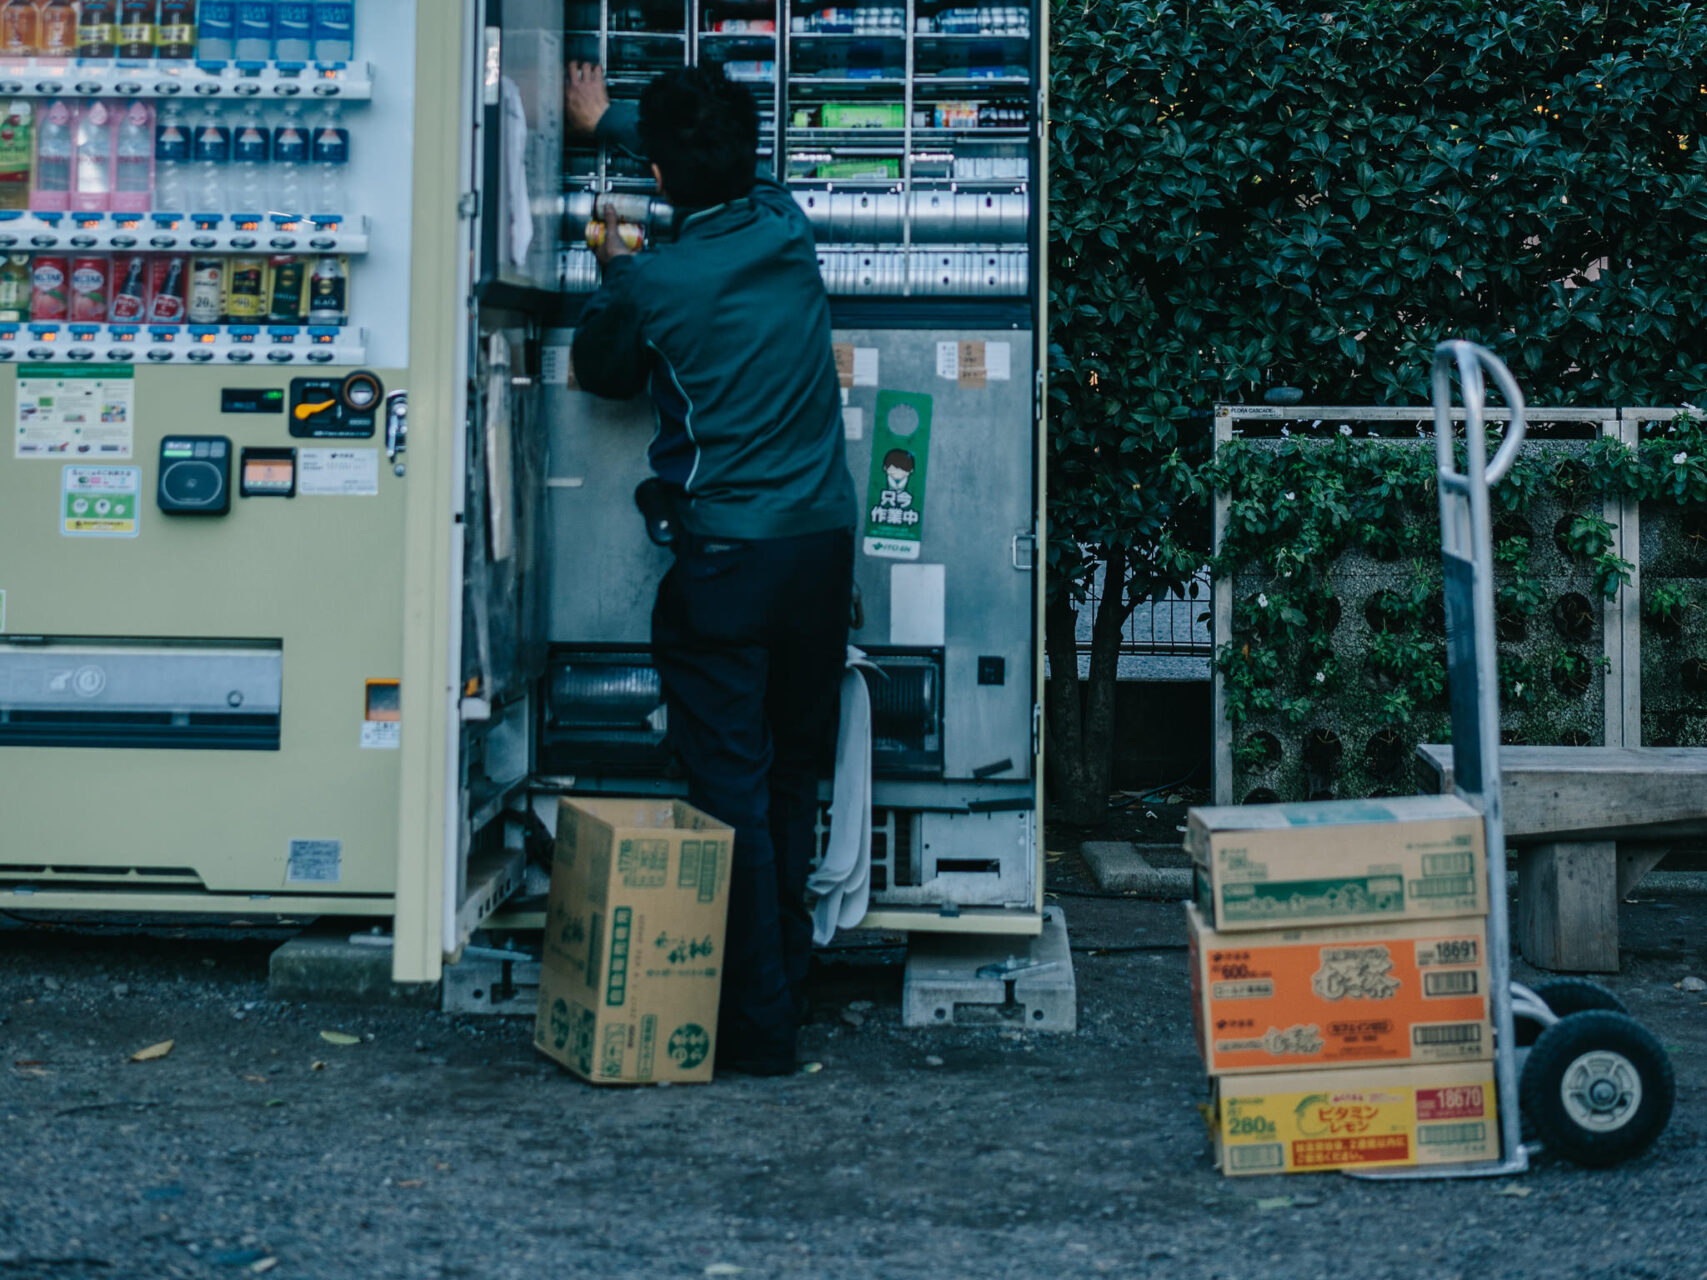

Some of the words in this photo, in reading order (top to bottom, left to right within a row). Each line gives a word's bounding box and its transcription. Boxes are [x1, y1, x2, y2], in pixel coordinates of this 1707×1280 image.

[880, 490, 913, 508] 只今
[871, 506, 919, 526] 作業中
[1436, 940, 1478, 959] 18691
[1437, 1087, 1481, 1108] 18670
[1318, 1106, 1379, 1122] ビタミン
[1330, 1121, 1370, 1134] レモン
